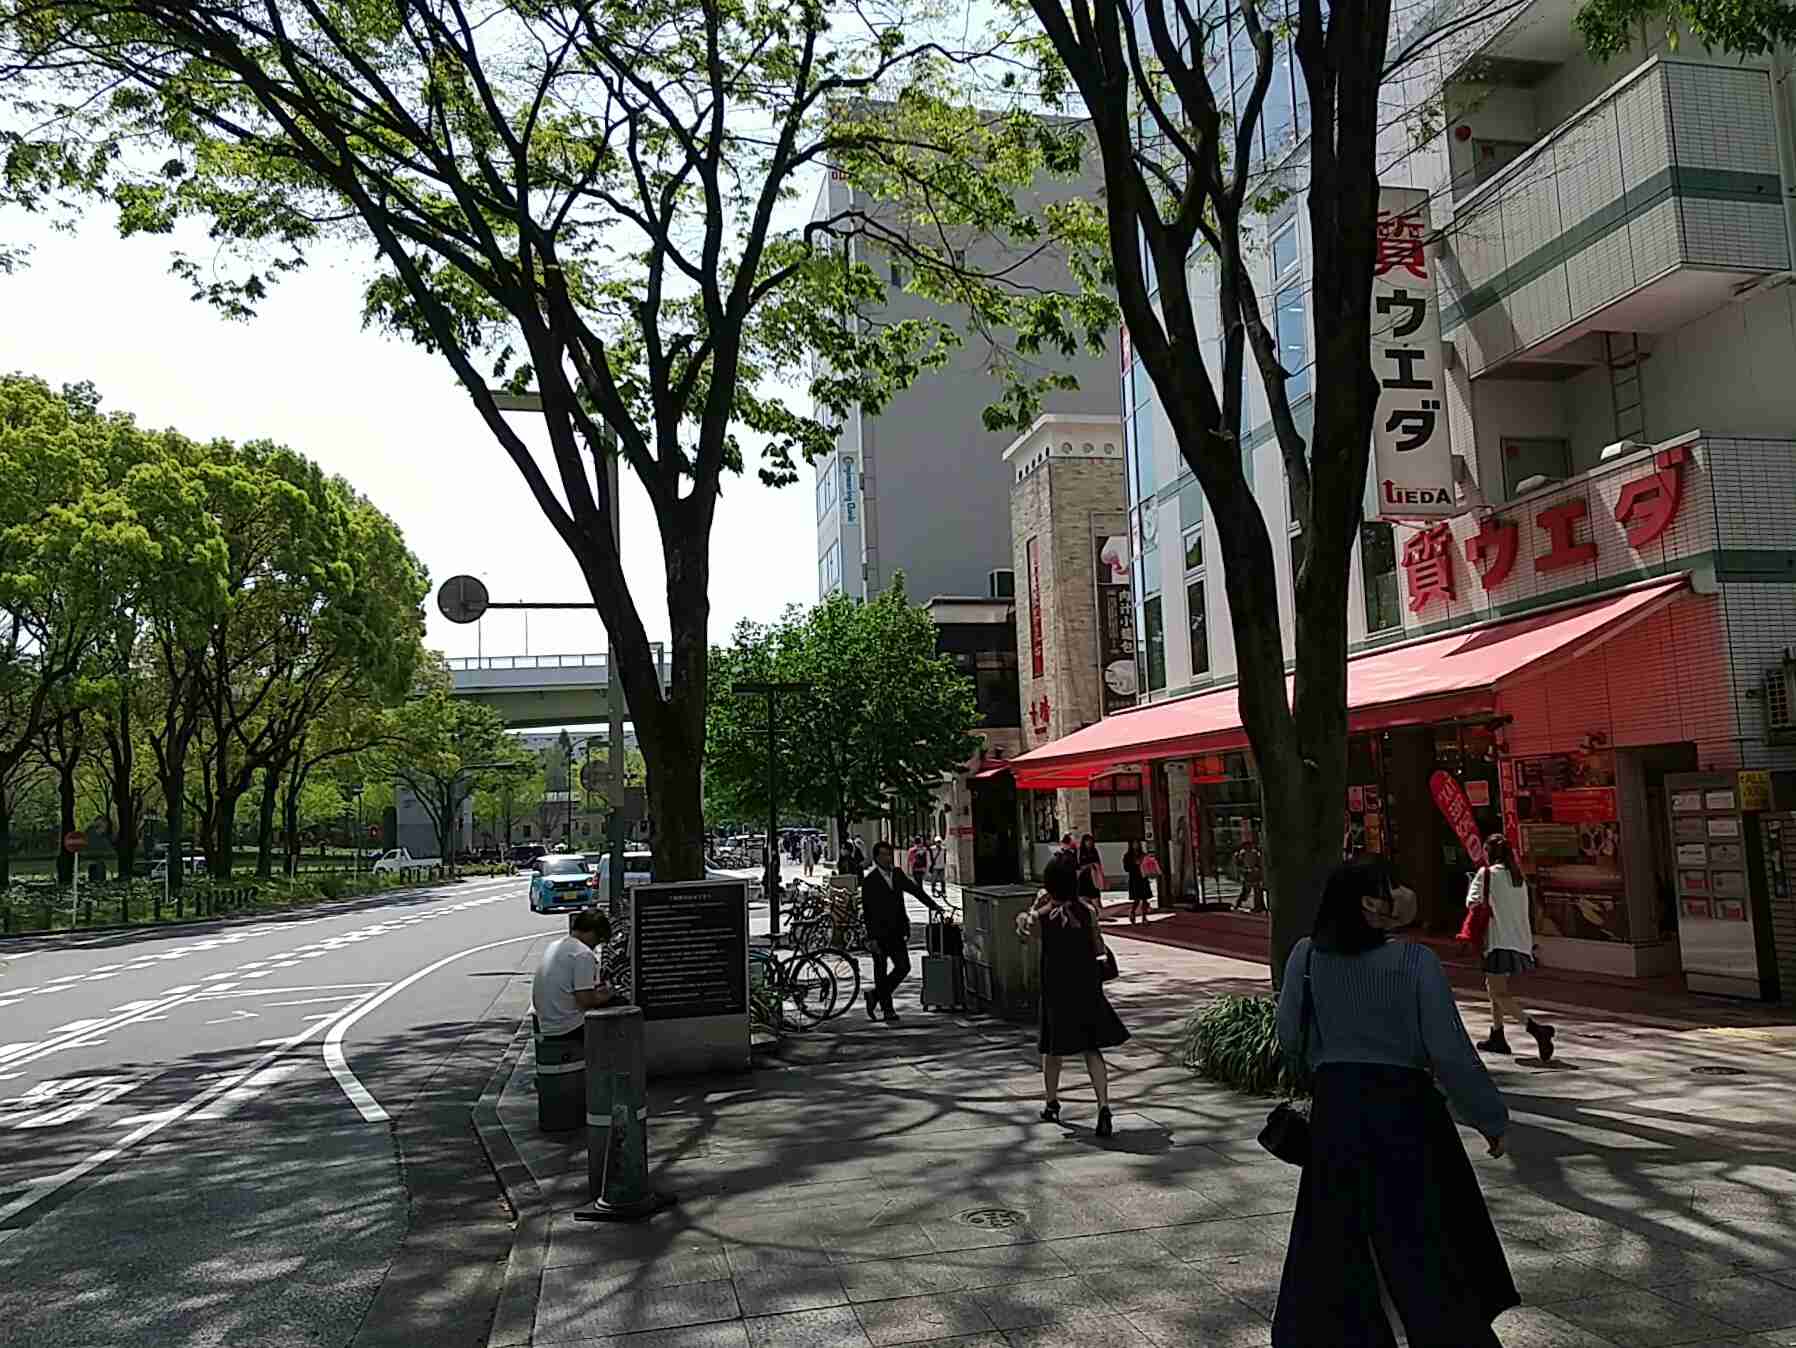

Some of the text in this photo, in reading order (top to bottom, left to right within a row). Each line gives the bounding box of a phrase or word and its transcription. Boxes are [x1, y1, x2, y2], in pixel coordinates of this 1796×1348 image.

[1375, 209, 1441, 452] 質ウエダ
[1383, 480, 1452, 504] UEDA
[1401, 446, 1691, 613] 質ウエダ
